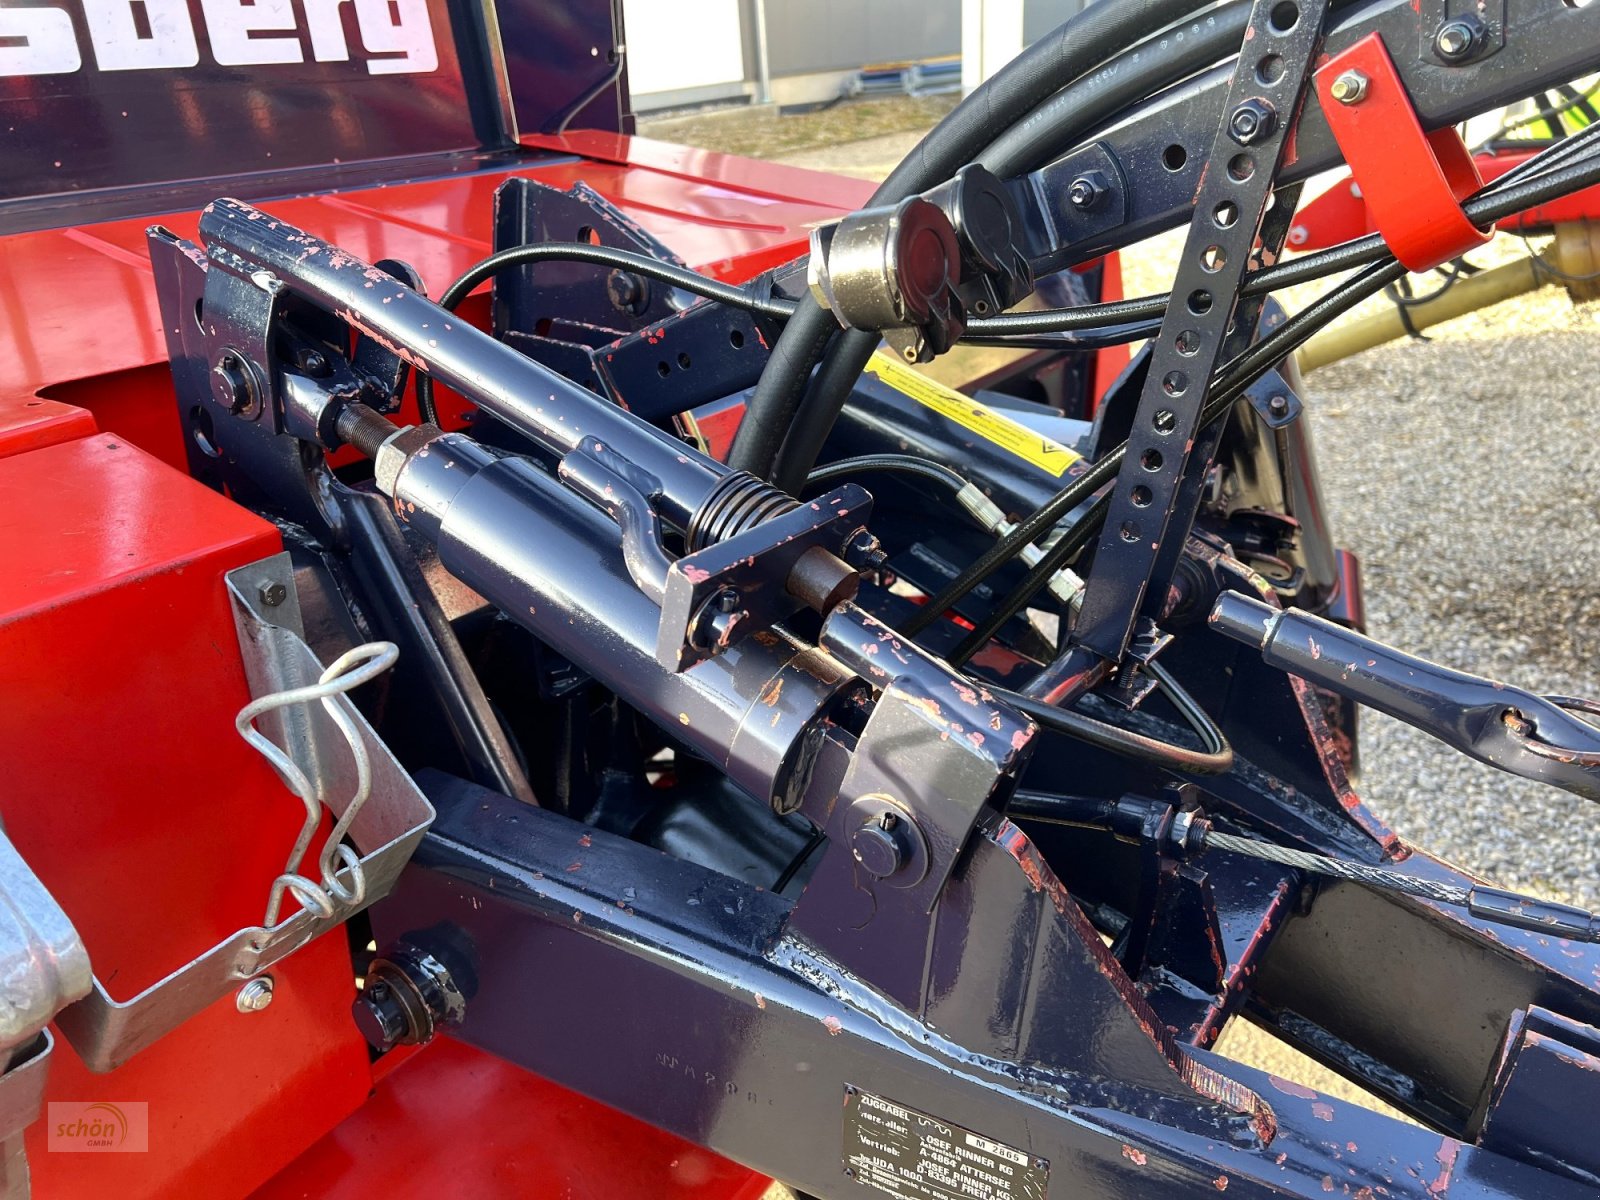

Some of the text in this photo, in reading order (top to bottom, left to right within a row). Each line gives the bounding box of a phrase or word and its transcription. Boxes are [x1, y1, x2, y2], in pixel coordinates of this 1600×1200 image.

[861, 1095, 911, 1122] ZUGGABEL
[859, 1134, 901, 1157] Vertrieb:
[976, 1139, 1020, 1161] M 2865
[872, 1156, 895, 1172] UDA
[899, 1166, 923, 1182] 1000
[919, 1147, 1011, 1190] A-4864 ATTERSEE
[954, 1146, 996, 1169] RINNER
[998, 1163, 1014, 1176] KG
[916, 1164, 958, 1188] D-83395
[918, 1158, 1011, 1200] JOSEF RINNER KG
